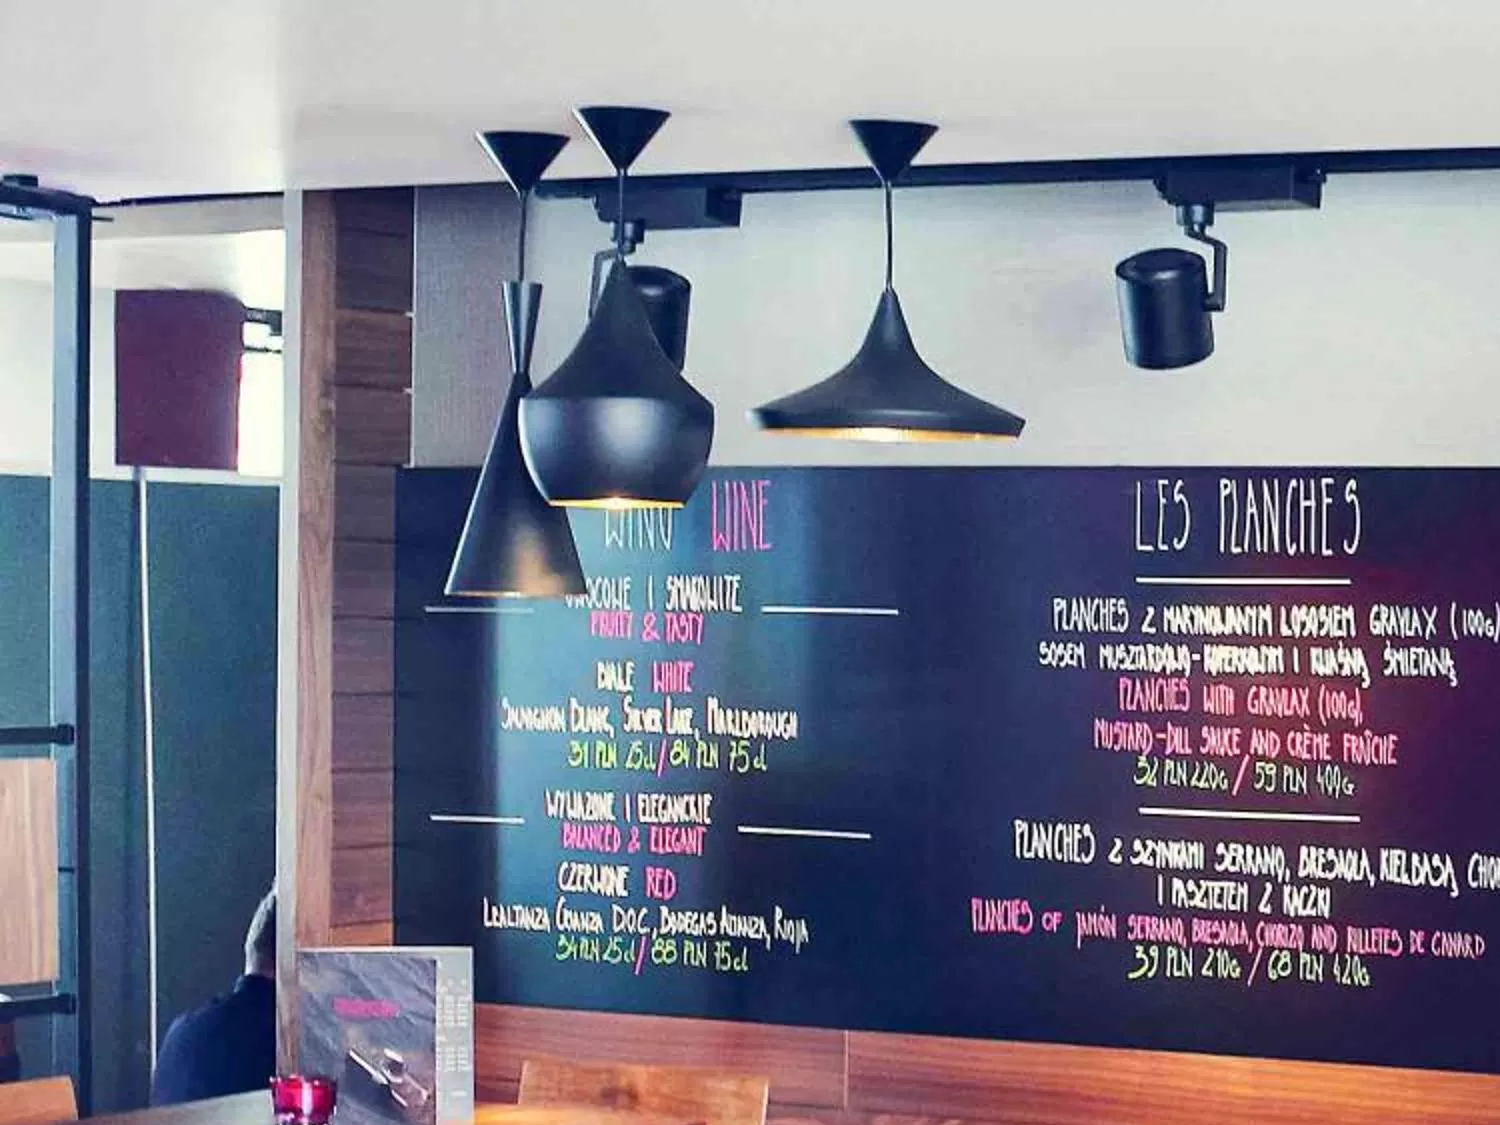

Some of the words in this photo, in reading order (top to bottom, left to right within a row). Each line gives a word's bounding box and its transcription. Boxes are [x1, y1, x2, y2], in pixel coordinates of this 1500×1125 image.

[711, 479, 772, 553] WINE
[1136, 478, 1190, 554] LES
[1219, 477, 1360, 557] PLANCHES
[642, 612, 661, 643] &
[665, 613, 705, 646] TASTY
[1053, 597, 1129, 634] PLANCHES
[1369, 603, 1438, 641] GRAVLAX
[1039, 640, 1086, 669] SOSEM
[652, 660, 695, 693] WHITE
[1119, 676, 1190, 713] PLANCHES
[1203, 685, 1235, 716] WITH
[1247, 685, 1310, 717] GRAVLAX
[595, 740, 617, 769] PLN
[697, 740, 719, 770] PLN
[1200, 723, 1242, 758] SAUCE
[1250, 725, 1281, 758] AND
[1164, 759, 1189, 788] PLN
[1254, 760, 1277, 791] 59
[1283, 763, 1308, 795] PLN
[562, 822, 621, 854] BALANCED
[628, 827, 641, 855] &
[650, 826, 707, 857] ELEGANT
[1014, 819, 1096, 865] PLANCHES
[1130, 837, 1205, 870] SZYNKAMI
[558, 860, 630, 898] CZERWONE
[645, 866, 677, 900] RED
[1172, 880, 1249, 913] PASZTETEM
[1283, 885, 1332, 919] KACZKI
[971, 897, 1034, 936] PLANCHES
[1042, 912, 1063, 934] OF
[1256, 920, 1305, 952] CHORIZO
[1311, 923, 1338, 954] AND
[1410, 929, 1425, 954] DE
[1432, 929, 1486, 960] CANARD
[684, 939, 707, 969] PLN
[1127, 945, 1158, 979] 39
[1166, 948, 1193, 978] PLN
[1268, 950, 1292, 981] 68
[1299, 952, 1324, 984] PLN
